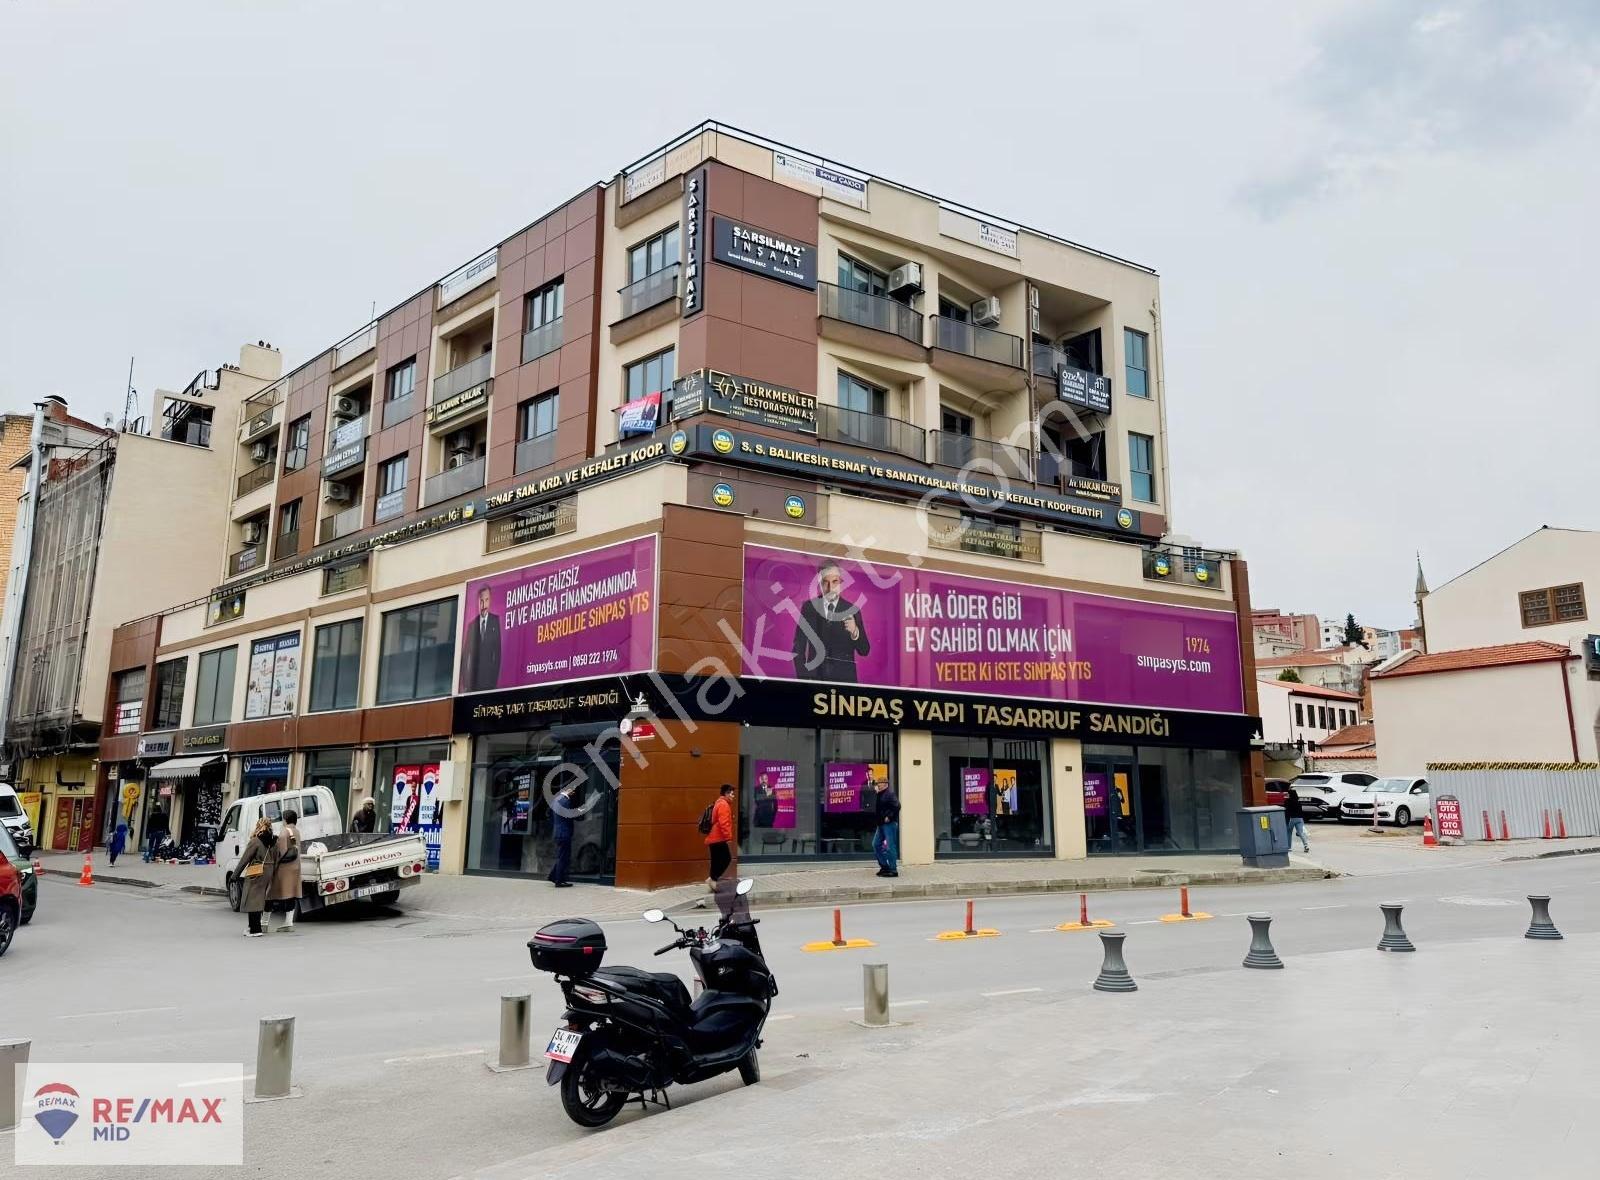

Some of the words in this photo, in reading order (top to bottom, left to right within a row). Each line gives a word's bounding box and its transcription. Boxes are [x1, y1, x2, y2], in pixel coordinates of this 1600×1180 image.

[686, 178, 698, 309] SARSILMAZ
[733, 226, 801, 257] SARSILMAZ
[733, 236, 801, 268] İNŞAAT
[743, 382, 814, 410] TÜRKMENLER
[743, 397, 801, 418] RESTORASYON
[516, 483, 538, 500] SAN.
[539, 475, 563, 492] KRD.
[565, 468, 579, 484] VE
[581, 454, 628, 479] KEFALET
[630, 442, 665, 463] KOOP.
[741, 441, 752, 452] S.
[755, 444, 766, 455] S.
[769, 447, 829, 467] BALIKESİR
[831, 458, 867, 475] ESNAF
[870, 466, 888, 477] VE
[885, 468, 959, 491] SANATKARLAR
[961, 483, 989, 498] KREDİ
[992, 488, 1005, 500] VE
[1006, 492, 1046, 509] KEFALET
[1047, 501, 1104, 520] KOOPERATİFİ
[504, 612, 516, 630] EV
[517, 607, 528, 626] VE
[530, 599, 558, 622] ARABA
[560, 569, 638, 612] FİNANSMANINDA
[506, 581, 546, 608] BANKASIZ
[548, 564, 580, 594] FAİZSİZ
[537, 612, 587, 645] BAŞROLDE
[628, 590, 649, 616] YTS
[904, 589, 942, 619] KİRA
[947, 590, 989, 620] ÖDER
[992, 591, 1022, 620] GİBİ
[905, 626, 926, 652] EV
[931, 623, 983, 653] SAHİBİ
[987, 628, 1039, 653] OLMAK
[1043, 624, 1072, 659] İÇİN
[1185, 636, 1211, 655] 1974
[526, 655, 568, 676] sinpasyts.com
[572, 653, 588, 667] 0850
[588, 652, 601, 665] 222
[602, 649, 618, 662] 1974
[935, 662, 977, 682] YETER
[1068, 661, 1092, 680] YTS
[1136, 655, 1212, 674] sinpasyts.com
[472, 704, 504, 718] SİNPAŞ
[506, 702, 526, 715] YAPI
[528, 699, 575, 713] TASARRUF
[813, 688, 904, 725] SİNPAŞ
[913, 700, 965, 723] YAPI
[972, 702, 1081, 730] TASARRUF
[1089, 711, 1170, 737] SANDIĞI
[1442, 821, 1458, 829] OTO
